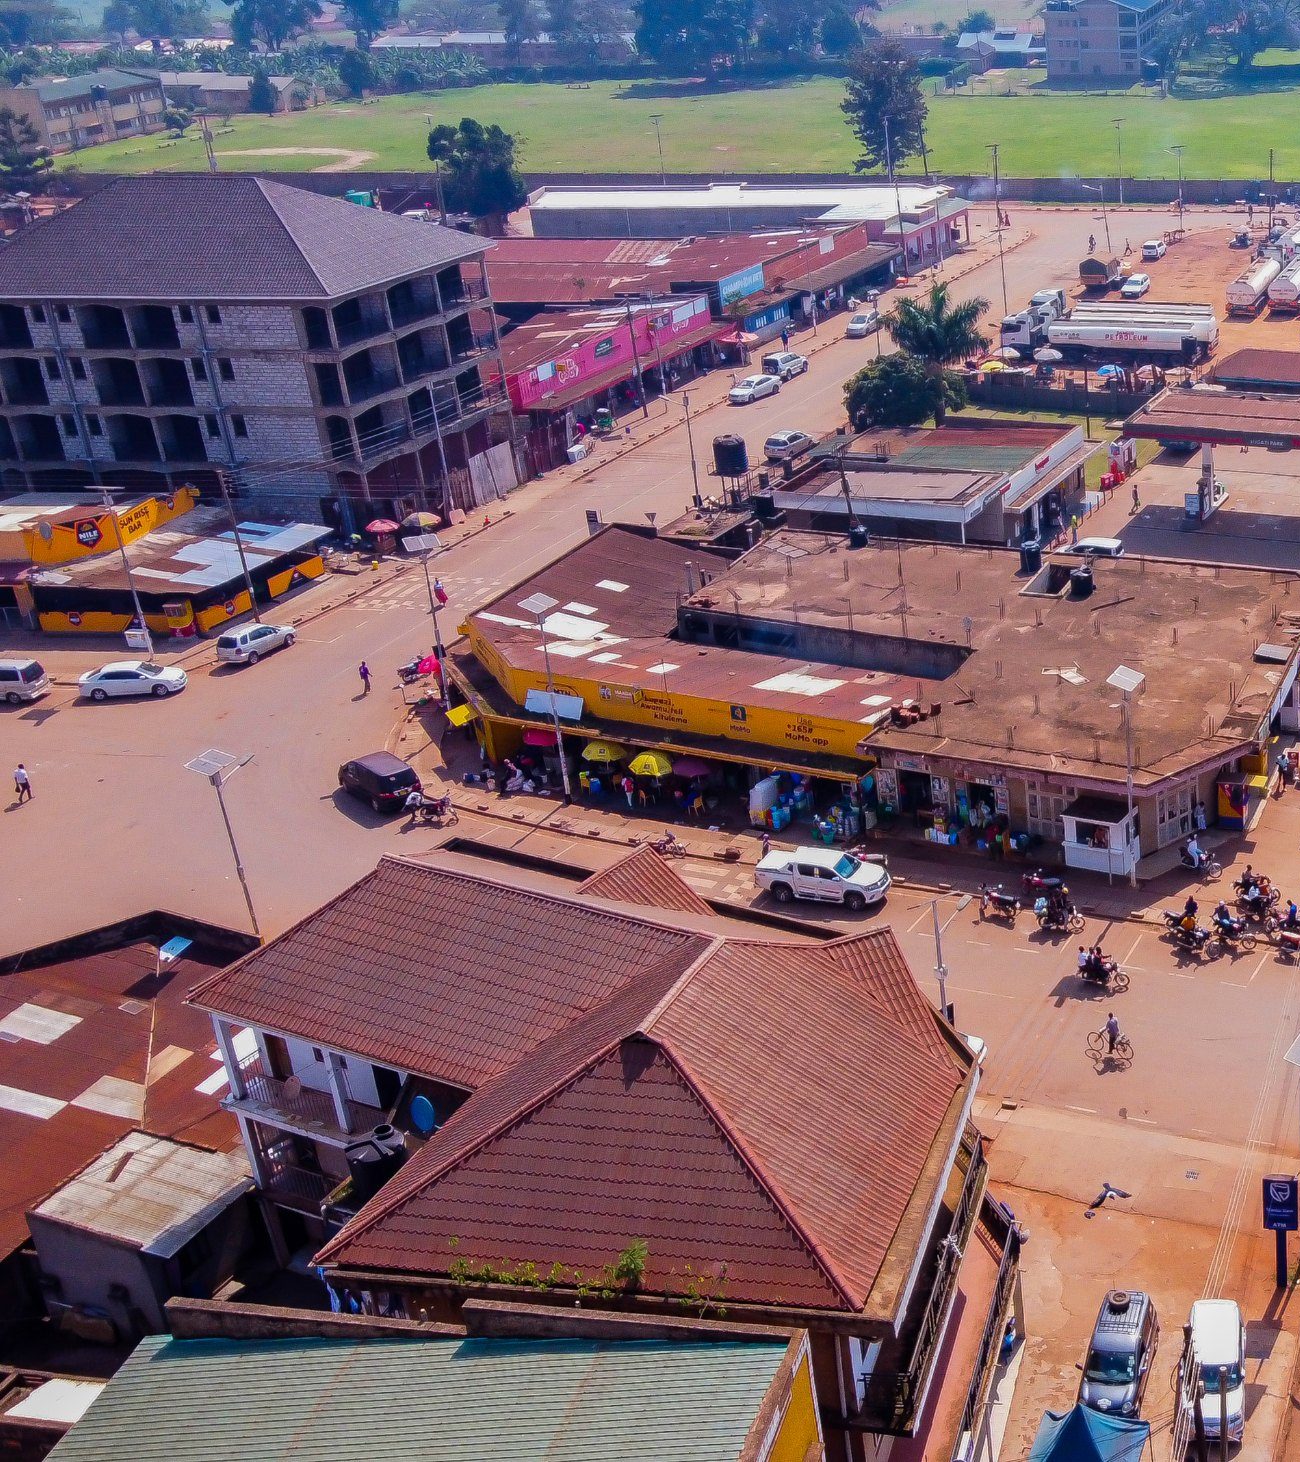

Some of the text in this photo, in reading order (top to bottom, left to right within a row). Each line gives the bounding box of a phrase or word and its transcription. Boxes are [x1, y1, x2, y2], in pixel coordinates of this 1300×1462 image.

[120, 506, 149, 529] SUN RISE
[128, 521, 142, 533] BAR
[79, 530, 98, 540] NILE
[797, 716, 812, 726] Use
[785, 732, 829, 746] MoMo app
